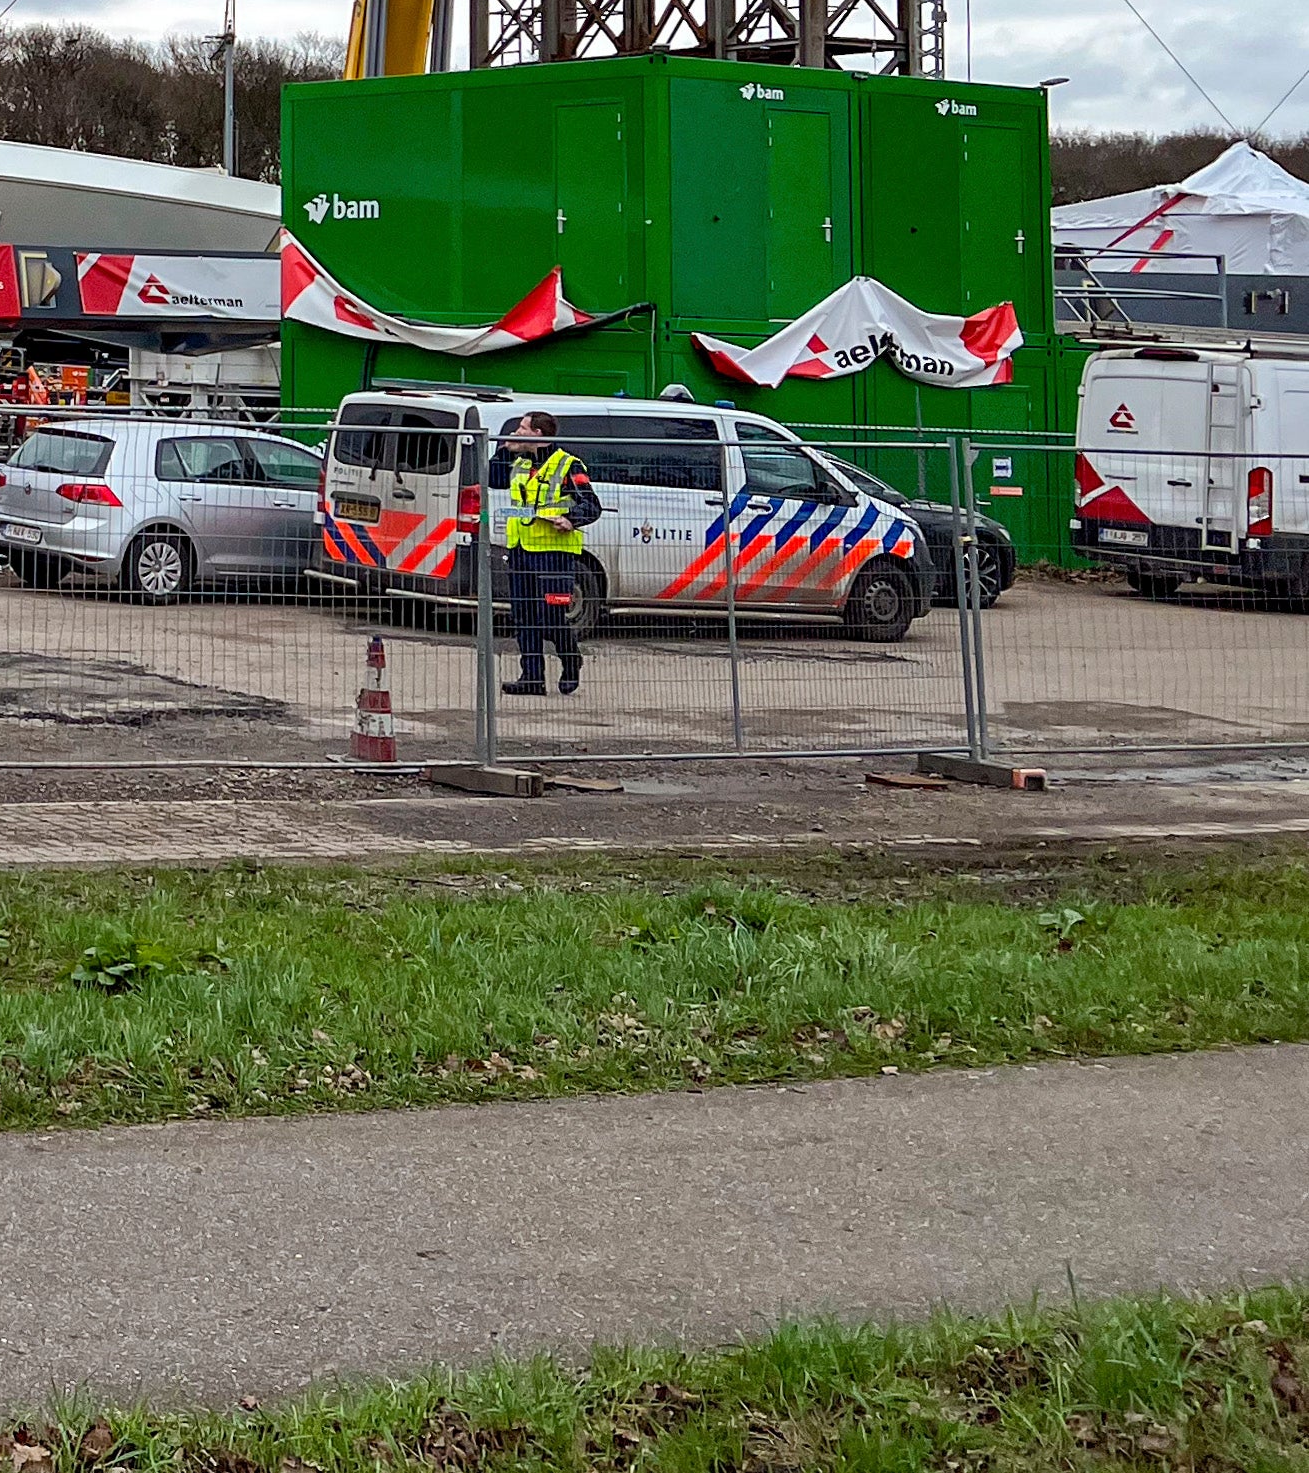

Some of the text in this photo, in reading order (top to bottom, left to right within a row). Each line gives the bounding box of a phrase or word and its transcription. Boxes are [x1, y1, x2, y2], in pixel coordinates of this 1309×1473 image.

[756, 84, 784, 101] bam
[950, 100, 977, 116] bam
[333, 193, 380, 219] bam
[171, 294, 244, 308] aelterman
[633, 527, 692, 544] POLITIE
